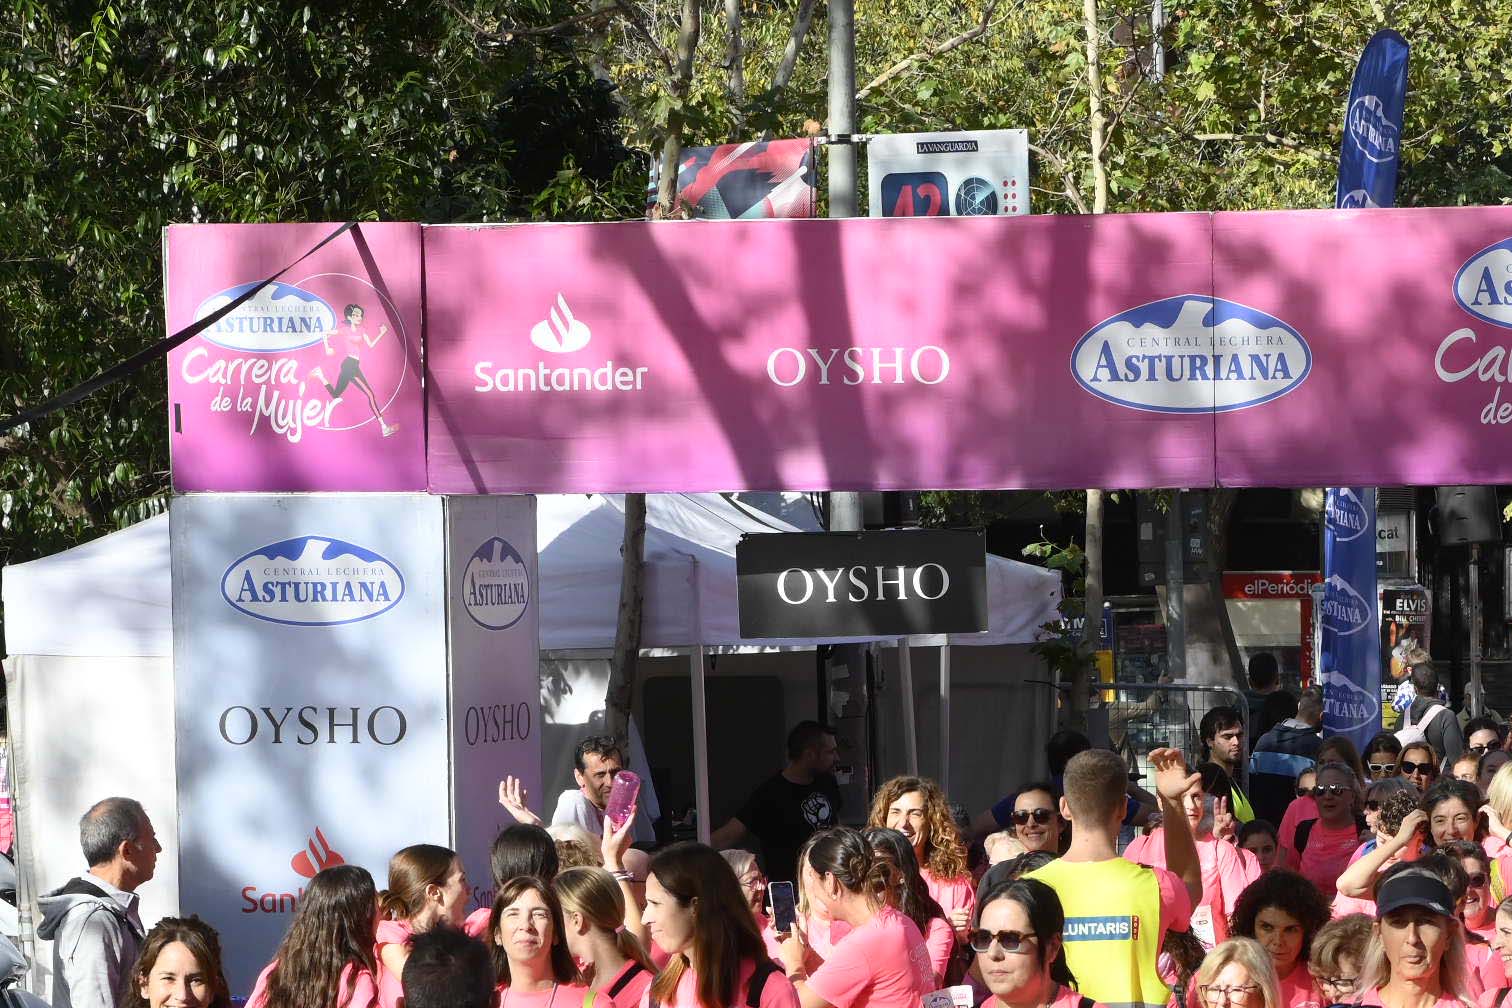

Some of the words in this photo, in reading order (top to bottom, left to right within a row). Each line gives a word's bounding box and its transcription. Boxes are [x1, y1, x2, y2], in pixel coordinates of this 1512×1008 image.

[928, 142, 977, 152] VANGUARDIA
[1126, 335, 1201, 347] CENTRAL
[1208, 334, 1285, 346] LECHERA
[182, 347, 299, 384] Carrera
[474, 360, 648, 393] Santander
[766, 345, 950, 387] OYSHO
[1090, 342, 1293, 384] ASTURIANA
[211, 385, 232, 412] de
[237, 387, 253, 412] la
[249, 380, 343, 443] Mujer
[236, 570, 391, 603] ASTURIANA
[263, 567, 321, 577] CENTRAL
[327, 566, 385, 576] LECHERA
[776, 562, 950, 605] OYSHO
[1244, 579, 1312, 595] elPeriódi
[467, 574, 525, 607] ASTURIANA
[1396, 599, 1426, 611] ELVIS
[219, 704, 407, 746] OYSHO
[464, 702, 531, 747] OYSHO
